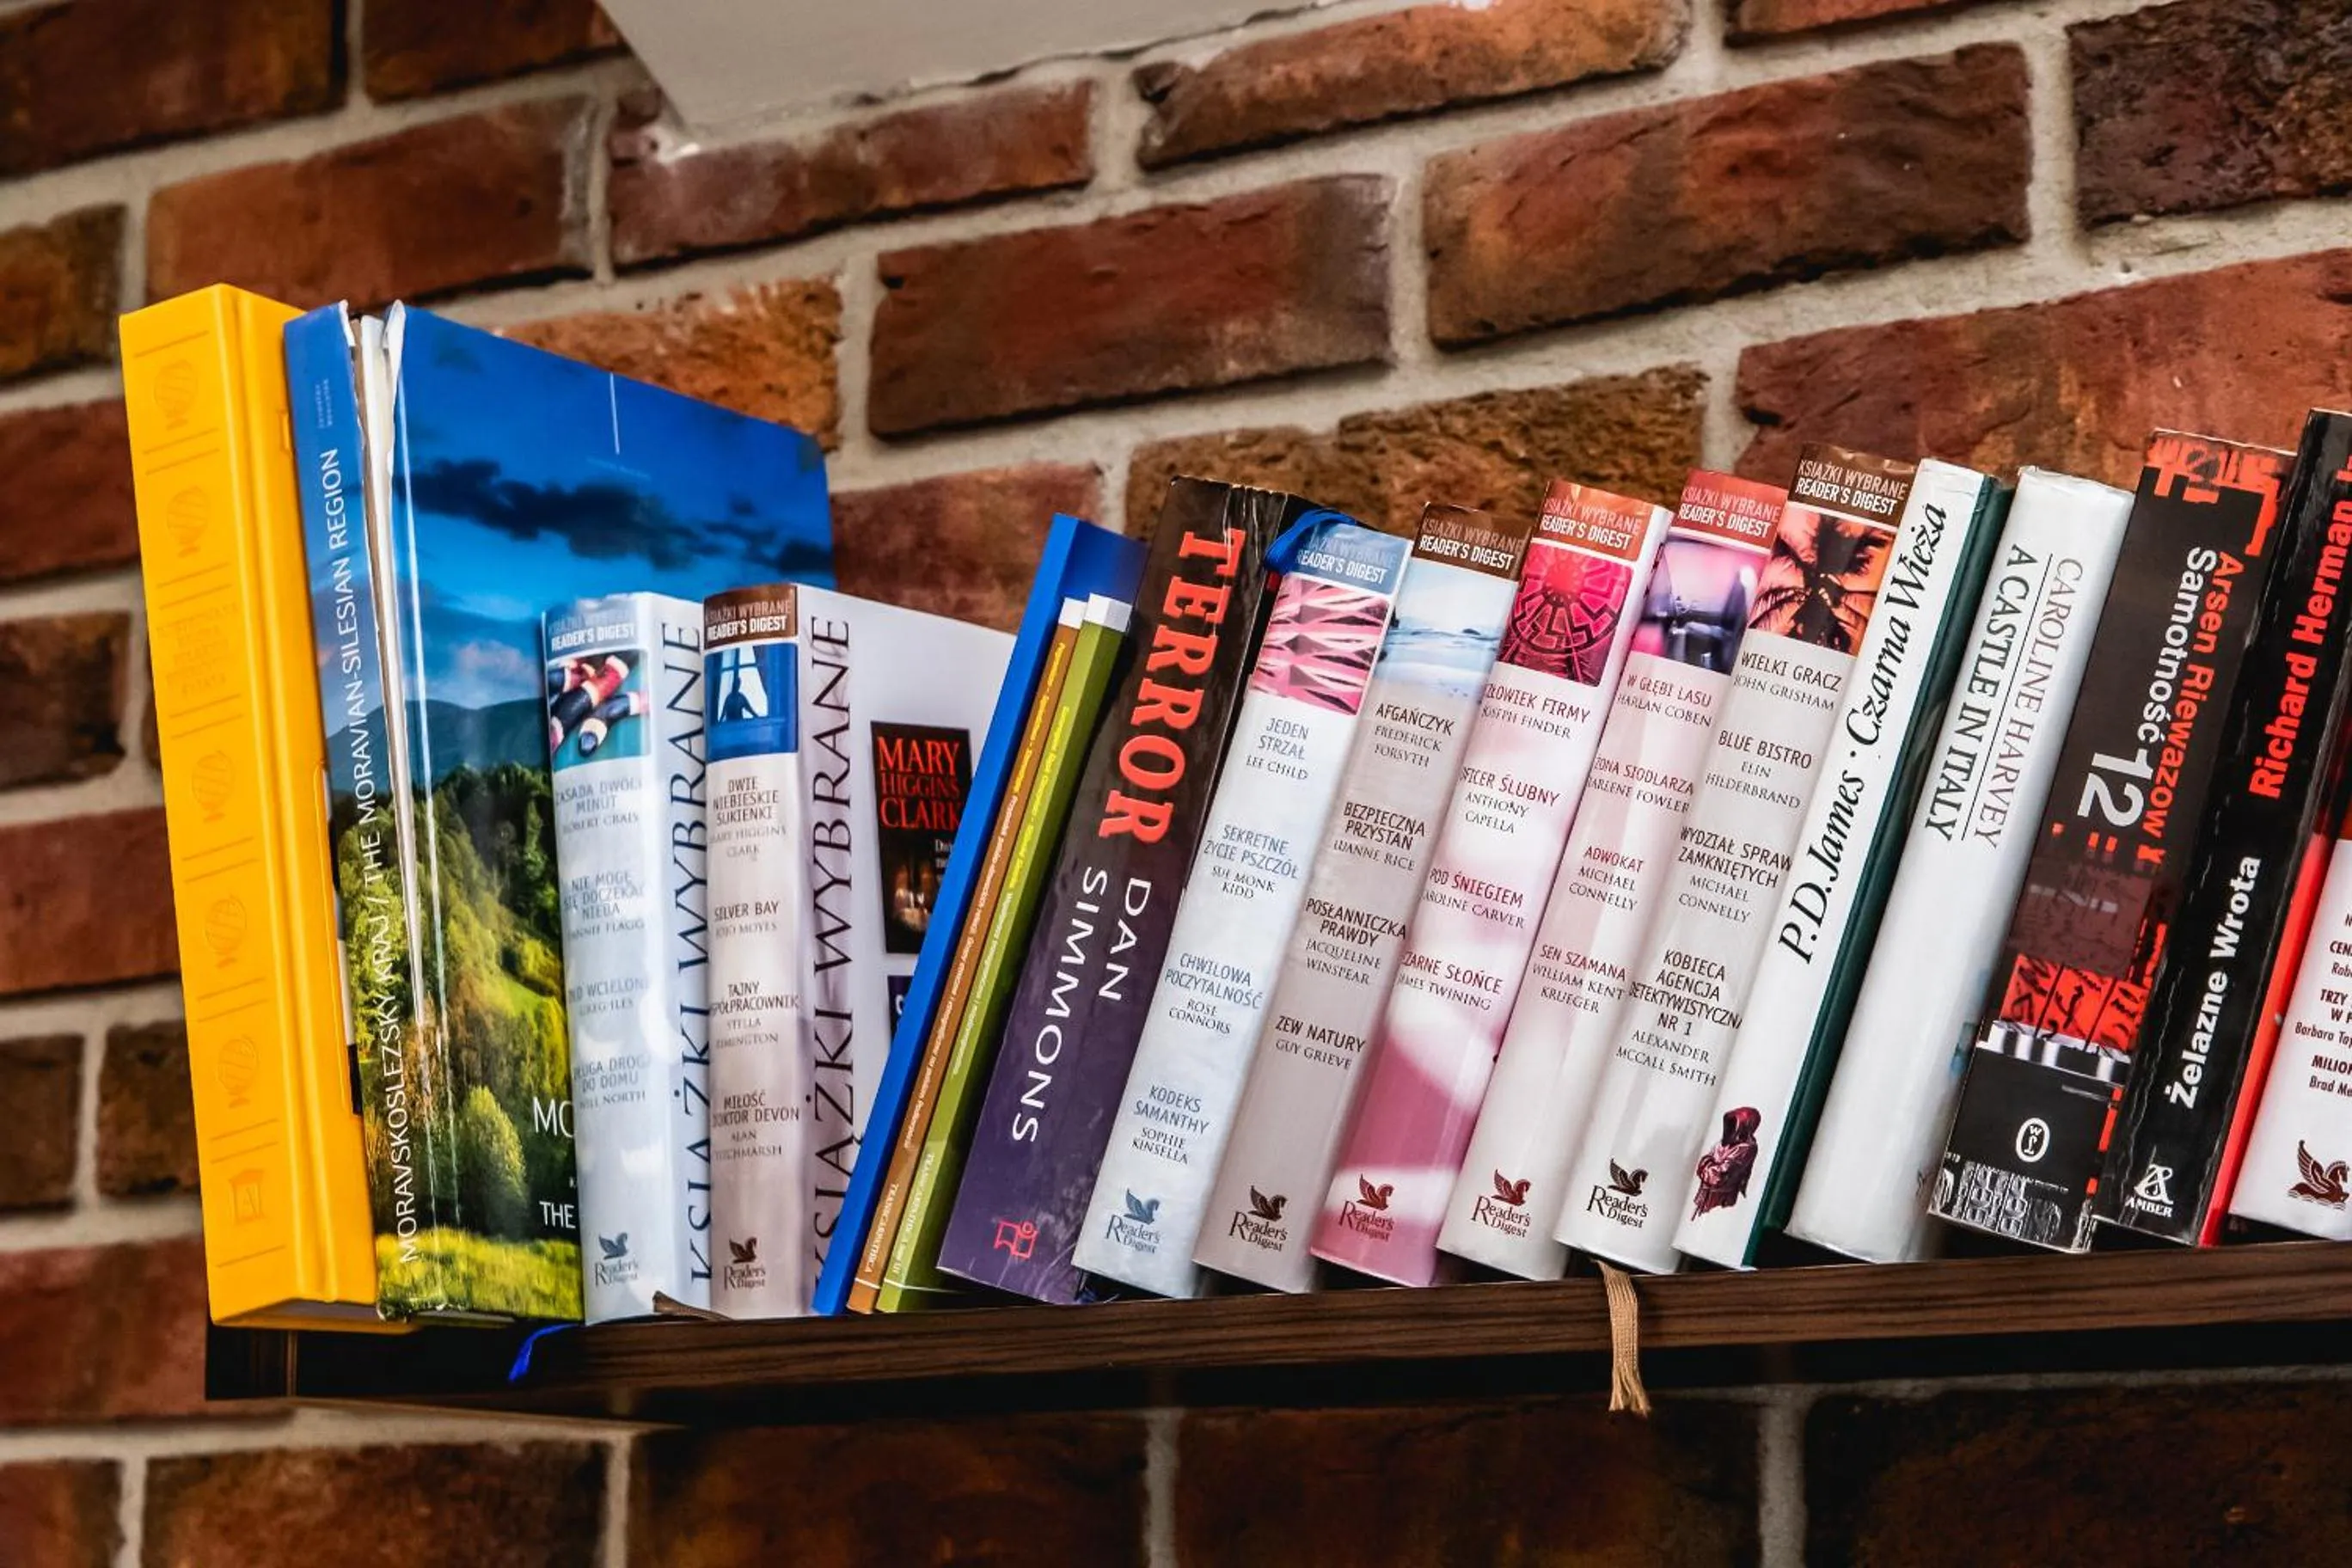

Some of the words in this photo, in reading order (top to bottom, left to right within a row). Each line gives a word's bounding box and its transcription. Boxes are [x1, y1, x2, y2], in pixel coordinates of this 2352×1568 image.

[320, 448, 351, 551] REGION
[1795, 477, 1850, 504] READER'S
[1852, 491, 1897, 515] DIGEST
[1845, 469, 1908, 500] WYBRANE
[1581, 505, 1642, 534] WYBRANE
[1678, 504, 1725, 527] READER'S
[1726, 514, 1771, 538] DIGEST
[1721, 493, 1782, 523] WYBRANE
[1466, 526, 1524, 554] WYBRANE
[1540, 514, 1587, 538] READER'S
[1589, 525, 1632, 550] DIGEST
[1419, 535, 1470, 559] READER'S
[1471, 546, 1514, 570] DIGEST
[2006, 544, 2038, 566] A
[1346, 560, 1389, 585] DIGEST
[2192, 551, 2244, 654] Arsen
[597, 623, 635, 641] DIGEST
[750, 616, 787, 634] DIGEST
[1846, 620, 1913, 746] Czarna
[1883, 500, 1948, 615] Wieża
[1967, 575, 2030, 697] CASTLE
[2014, 558, 2083, 714] CAROLINE
[2137, 546, 2217, 742] Samotność
[2249, 653, 2317, 799] Richard
[2292, 499, 2352, 645] Herman
[1098, 528, 1246, 844] TERROR
[1740, 651, 1787, 677] WIELKI
[1792, 665, 1843, 693] GRACZ
[330, 557, 381, 825] MORAVIAN-SILESIAN
[1627, 674, 1638, 687] W
[1640, 677, 1673, 696] GŁĘBI
[1677, 686, 1712, 707] LASU
[1733, 675, 1766, 693] JOHN
[1769, 686, 1835, 712] GRISHAM
[1376, 702, 1456, 737] AFGAŃCZYK
[1542, 698, 1590, 723] FIRMY
[1618, 695, 1662, 714] HARLAN
[1664, 705, 1712, 726] COBEN
[1954, 701, 1992, 742] IN
[1266, 718, 1309, 739] JEDEN
[1375, 726, 1442, 752] FREDERICK
[1521, 716, 1571, 738] FINDER
[878, 738, 959, 774] MARY
[1259, 735, 1305, 760] STRZAŁ
[1375, 744, 1430, 768] FORSYTH
[1718, 730, 1754, 752] BLUE
[1757, 740, 1812, 769] BISTRO
[2143, 665, 2215, 839] Riewazow
[1268, 760, 1308, 780] CHILD
[1624, 765, 1694, 795] SIODLARZA
[1741, 761, 1772, 778] ELIN
[1976, 714, 2035, 848] HARVEY
[663, 622, 708, 972] WYBRANE
[714, 790, 780, 810] NIEBIESKIE
[812, 616, 853, 977] WYBRANE
[881, 774, 959, 798] HIGGINS
[1499, 774, 1560, 806] ŚLUBNY
[1636, 789, 1690, 813] FOWLER
[1706, 773, 1801, 810] HILDERBRAND
[1925, 744, 1978, 841] ITALY
[2078, 747, 2153, 827] 12
[717, 807, 773, 826] SUKIENKI
[1344, 802, 1425, 837] BEZPIECZNA
[1466, 792, 1530, 818] ANTHONY
[1466, 810, 1515, 833] CAPELLA
[1223, 824, 1289, 854] SEKRETNE
[1680, 825, 1736, 854] WYDZIAŁ
[1741, 843, 1793, 872] SPRAW
[360, 830, 385, 889] THE
[1240, 850, 1300, 879] PSZCZÓŁ
[1383, 853, 1416, 871] RICE
[1583, 846, 1644, 873] ADWOKAT
[1678, 846, 1779, 888] ZAMKNIĘTYCH
[1222, 882, 1253, 899] KIDD
[1234, 873, 1276, 893] MONK
[1430, 868, 1449, 885] POD
[1452, 871, 1524, 908] ŚNIEGIEM
[1578, 867, 1636, 891] MICHAEL
[1690, 875, 1749, 903] MICHAEL
[755, 901, 780, 916] BAY
[1569, 882, 1638, 911] CONNELLY
[1679, 893, 1751, 923] CONNELLY
[1306, 897, 1406, 940] POSŁANNICZKA
[1472, 904, 1525, 928] CARVER
[1099, 877, 1152, 1001] DAN
[1320, 920, 1379, 947] PRAWDY
[365, 913, 396, 990] KRAJ
[1306, 939, 1381, 970] JACQUELINE
[1539, 945, 1560, 963] SEN
[1565, 952, 1626, 982] SZAMANA
[1663, 949, 1725, 982] KOBIECA
[1180, 952, 1251, 987] CHWILOWA
[1307, 958, 1370, 984] WINSPEAR
[1445, 964, 1504, 994] SŁOŃCE
[1533, 963, 1583, 989] WILLIAM
[1587, 979, 1625, 1002] KENT
[2165, 971, 2229, 1109] Żelazne
[2209, 856, 2261, 959] Wrota
[1165, 969, 1263, 1009] POCZYTALNOŚĆ
[1429, 983, 1492, 1011] TWINING
[1656, 969, 1720, 1001] AGENCJA
[2320, 989, 2348, 1006] TRZY
[1012, 867, 1108, 1142] SIMMONS
[1186, 999, 1217, 1016] ROSE
[1540, 987, 1599, 1014] KRUEGER
[2331, 1008, 2343, 1021] W
[1169, 1008, 1231, 1034] CONNORS
[1276, 1015, 1304, 1036] ZEW
[1307, 1025, 1366, 1053] NATURY
[1657, 1013, 1678, 1032] NR
[1684, 1022, 1692, 1036] 1
[2295, 1022, 2334, 1041] Barbara
[1276, 1038, 1302, 1054] GUY
[1303, 1047, 1352, 1070] GRIEVE
[1632, 1030, 1710, 1063] ALEXANDER
[1616, 1045, 1665, 1071] MCCALL
[1669, 1063, 1717, 1087] SMITH
[1149, 1085, 1202, 1112] KODEKS
[2309, 1075, 2335, 1095] Brad
[755, 1106, 799, 1122] DEVON
[1134, 1099, 1209, 1135] SAMANTHY
[1132, 1140, 1189, 1165] KINSELLA
[1141, 1127, 1186, 1149] SOPHIE
[540, 1200, 576, 1228] THE
[1338, 1200, 1394, 1230] Reader's
[1471, 1195, 1531, 1228] Reader's
[1586, 1185, 1648, 1218] Reader's
[2125, 1197, 2173, 1218] AMBER
[1105, 1215, 1161, 1244] Reader's
[1228, 1211, 1289, 1241] Reader's
[1491, 1218, 1528, 1238] Digest
[1607, 1208, 1644, 1229] Digest
[1248, 1233, 1283, 1252] Digest
